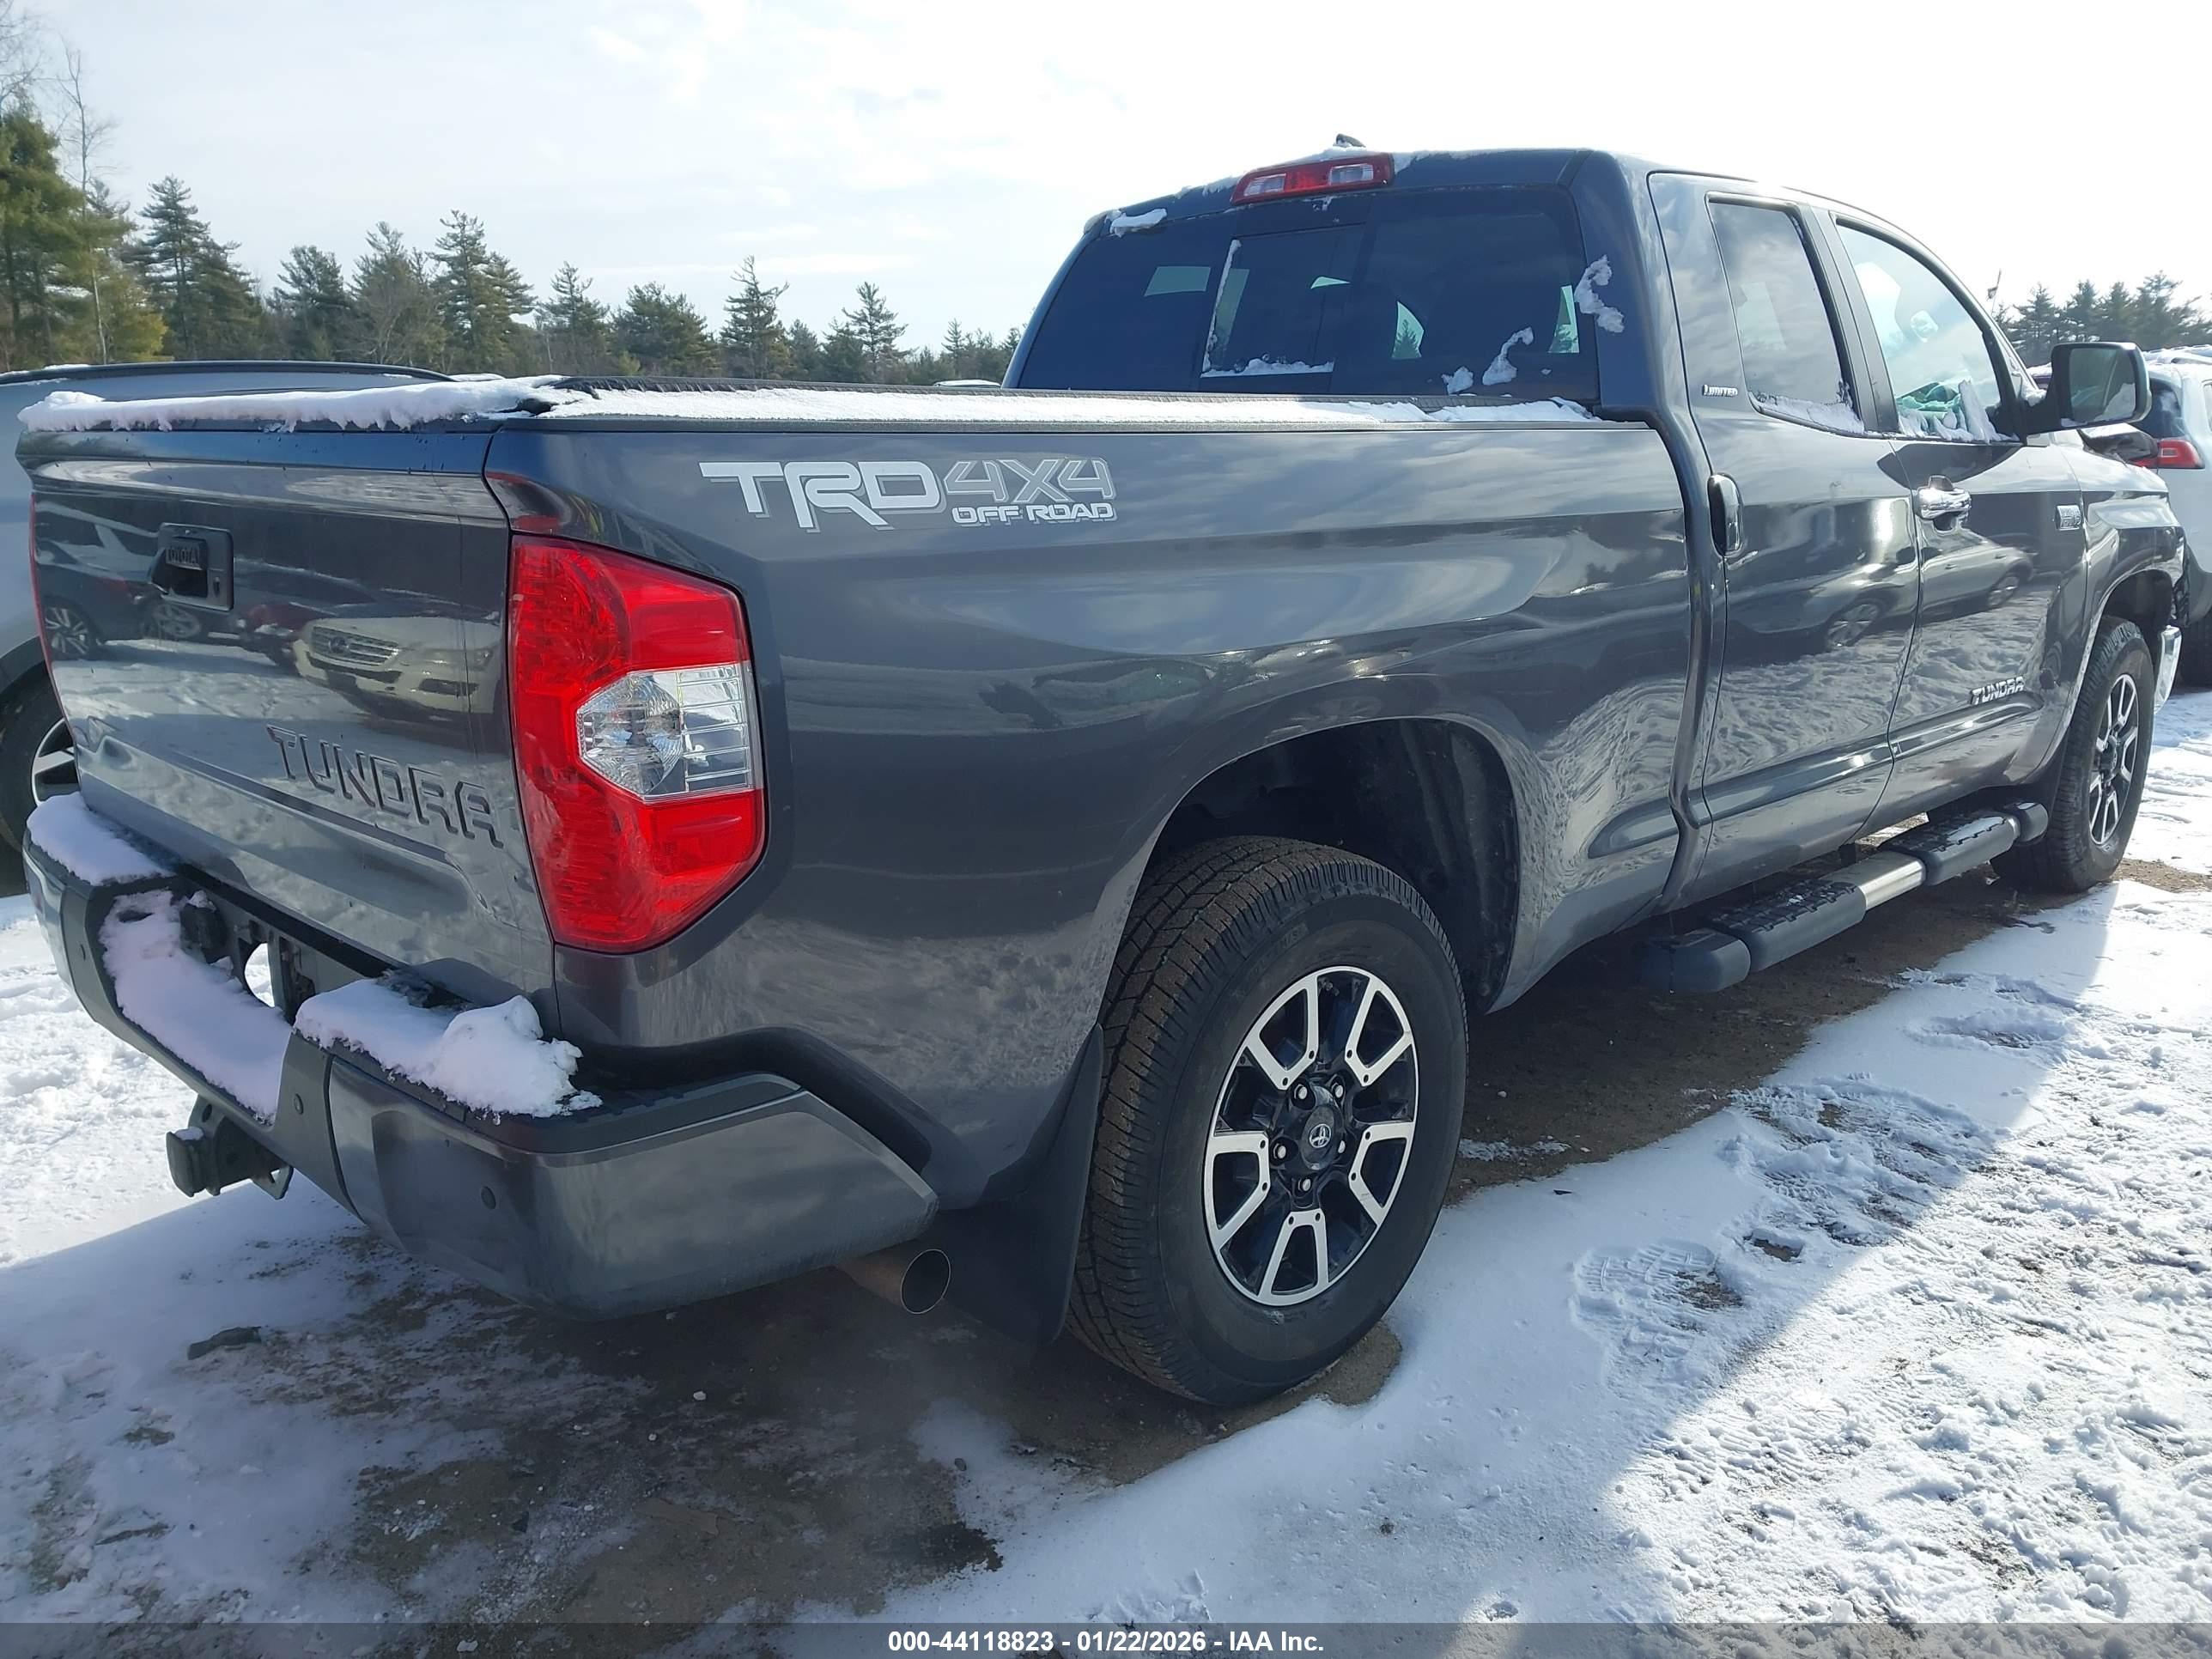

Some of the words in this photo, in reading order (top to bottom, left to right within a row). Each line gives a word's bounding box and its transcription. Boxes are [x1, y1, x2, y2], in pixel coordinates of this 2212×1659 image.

[698, 461, 945, 532] TRD
[944, 458, 1116, 503] 4X4
[951, 504, 1023, 526] OFF
[1025, 501, 1116, 524] ROAD
[1970, 676, 2025, 706] TUNDRA
[266, 724, 504, 849] TUNDRA
